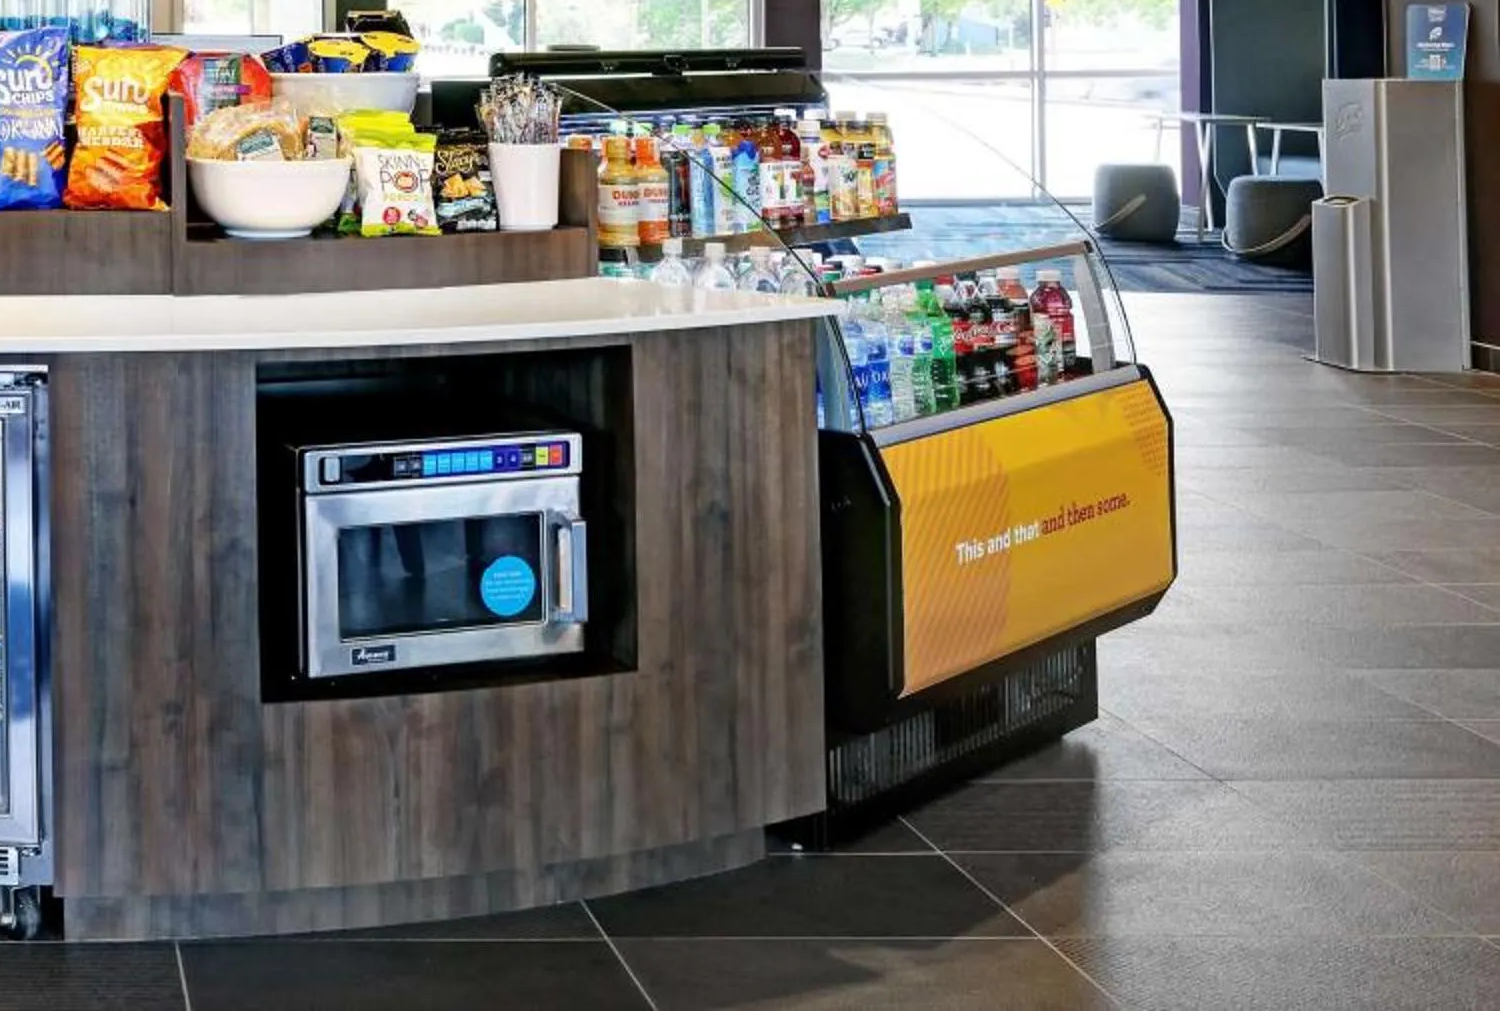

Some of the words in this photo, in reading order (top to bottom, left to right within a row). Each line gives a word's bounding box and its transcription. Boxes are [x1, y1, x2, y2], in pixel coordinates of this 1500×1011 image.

[11, 90, 54, 105] CHIPS
[80, 76, 149, 111] Sun
[380, 169, 431, 193] POP
[956, 538, 985, 564] This
[987, 527, 1011, 554] and
[1014, 518, 1040, 545] that
[1041, 506, 1065, 535] and
[1067, 500, 1095, 526] then
[1097, 492, 1131, 517] some.
